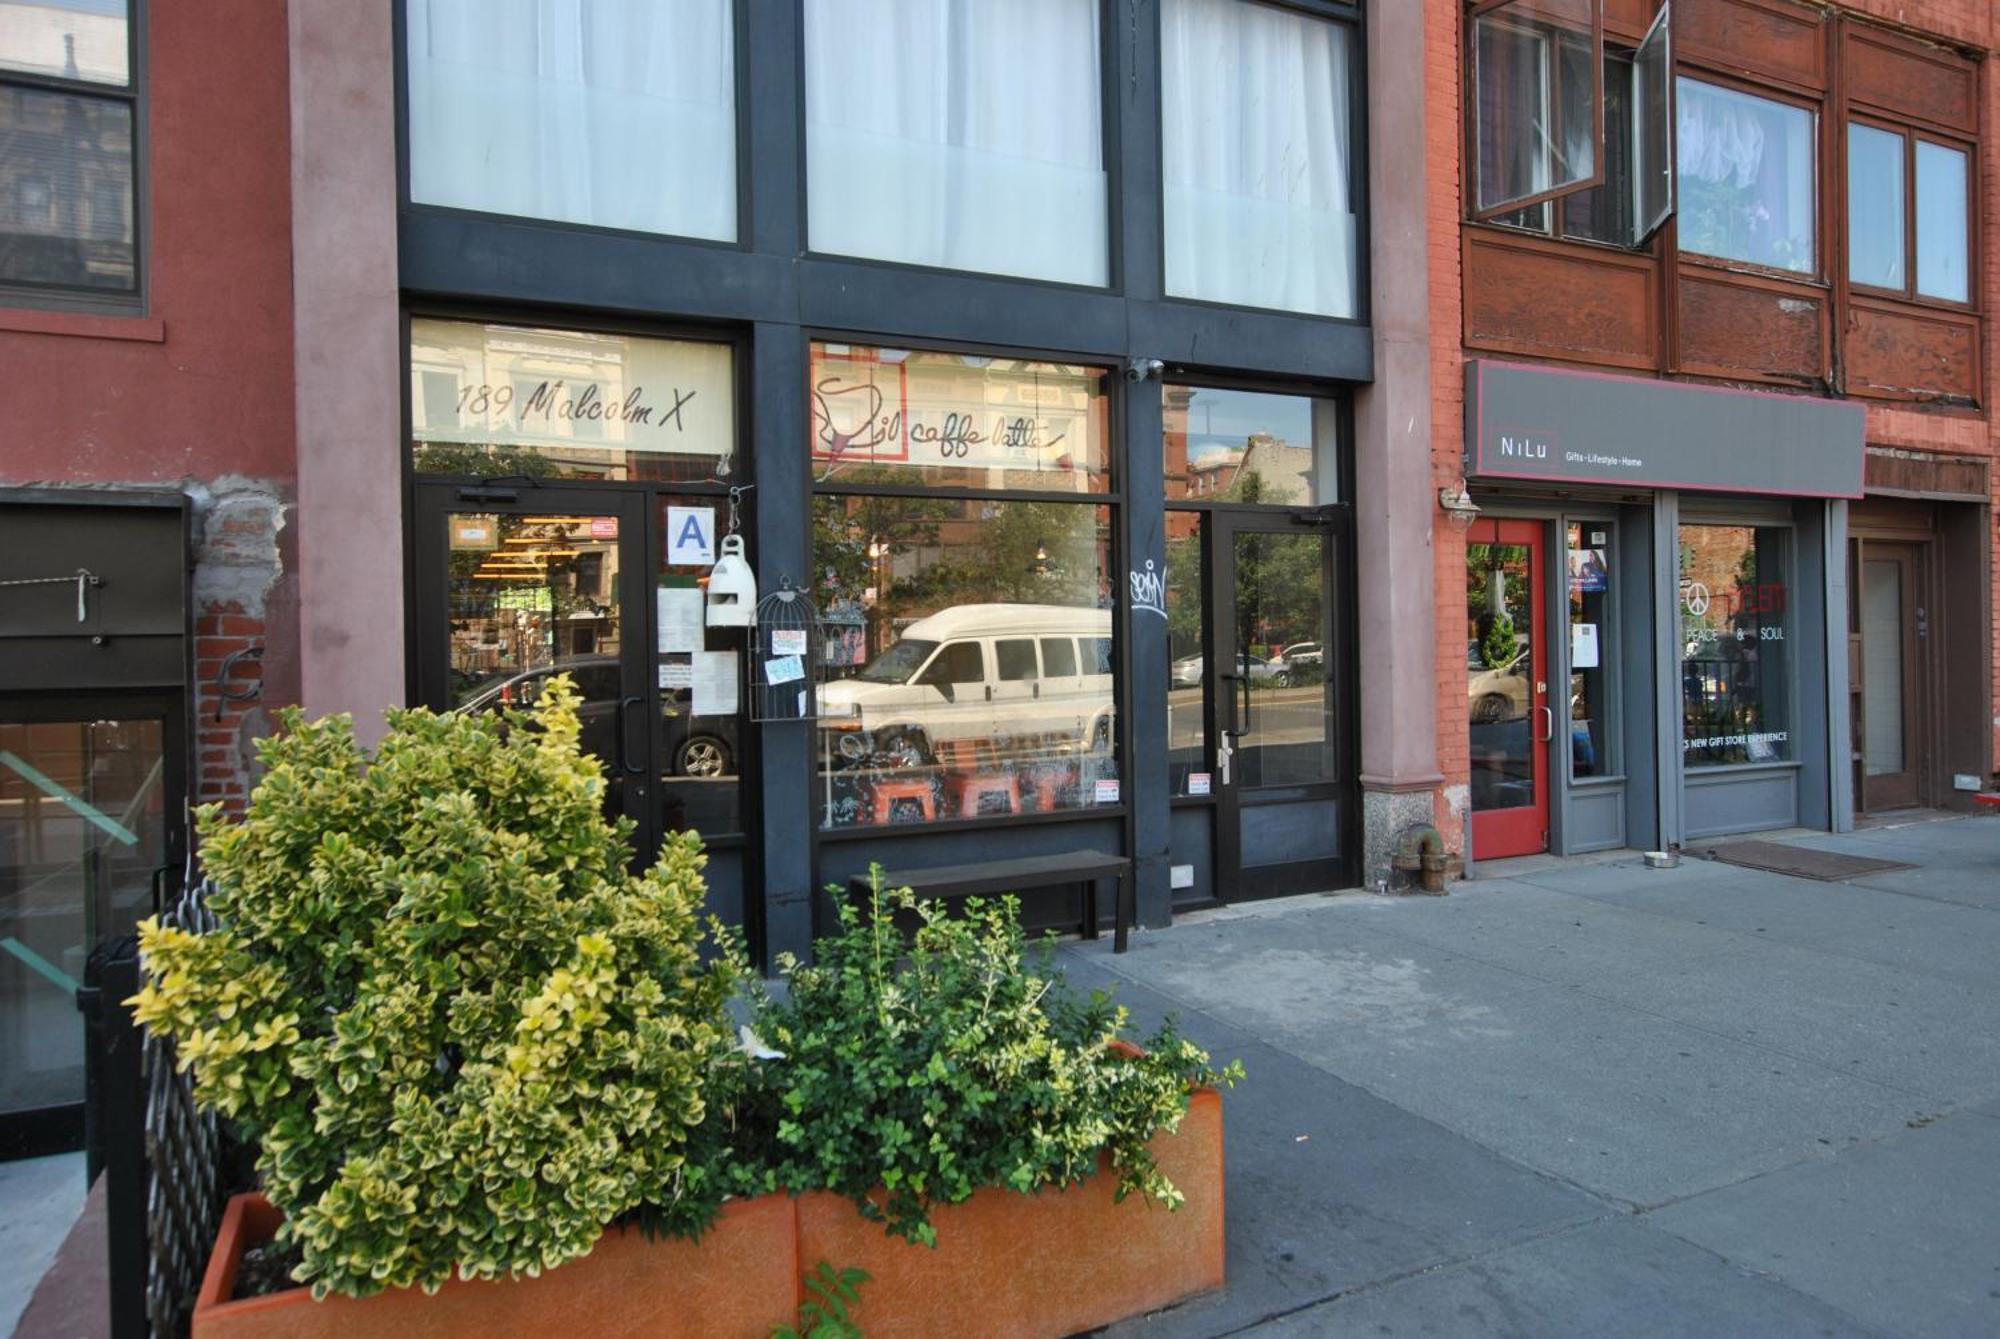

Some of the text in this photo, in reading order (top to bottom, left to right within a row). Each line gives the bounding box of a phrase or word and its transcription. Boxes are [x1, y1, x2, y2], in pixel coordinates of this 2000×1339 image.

[456, 380, 696, 431] 189 Malcolm X
[676, 515, 706, 549] A
[1686, 627, 1784, 642] PEACE & SOUL
[1690, 738, 1708, 749] NEW
[1708, 736, 1724, 747] GIFT
[1725, 734, 1746, 745] STORE
